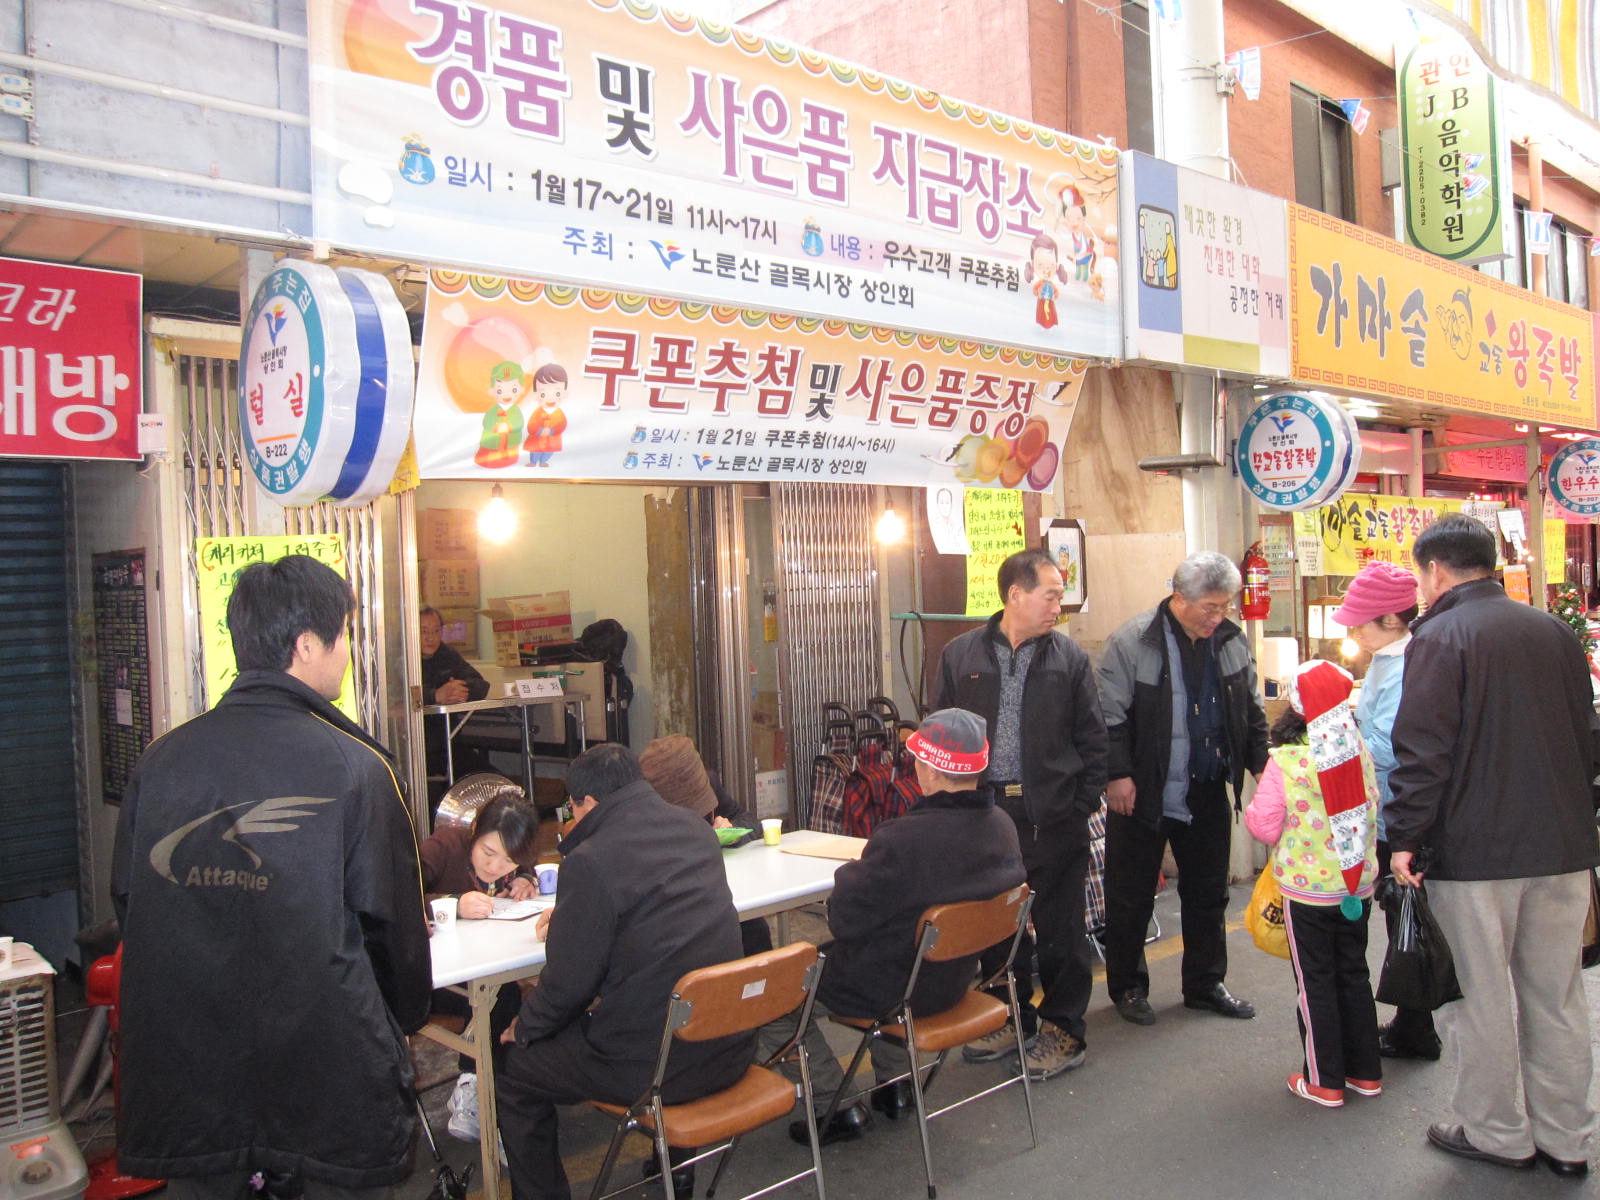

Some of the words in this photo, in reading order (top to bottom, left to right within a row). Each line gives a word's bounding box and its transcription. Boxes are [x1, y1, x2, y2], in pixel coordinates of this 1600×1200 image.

[412, 0, 568, 136] 경품
[599, 58, 653, 156] 및
[681, 72, 852, 201] 사은품
[872, 127, 1043, 241] 지급장소
[1437, 119, 1465, 242] 음악학원
[444, 156, 492, 192] 일시
[687, 206, 777, 245] 11시~17시
[1223, 215, 1242, 245] 환경
[563, 226, 613, 260] 주최
[692, 248, 760, 283] 노룬산
[770, 262, 850, 298] 골목시장
[860, 280, 914, 308] 상인회
[831, 235, 861, 261] 내용
[883, 241, 951, 279] 우수고객
[958, 256, 1020, 291] 쿠폰추첨
[1203, 245, 1235, 278] 친절한
[1242, 253, 1261, 283] 대화
[1230, 285, 1259, 316] 공정한
[1265, 292, 1283, 320] 거래
[1310, 262, 1430, 368] 가마솥
[584, 330, 801, 415] 쿠폰추첨
[806, 363, 841, 420] 및
[846, 358, 1036, 438] 사은품증정
[265, 444, 287, 458] B-222
[650, 428, 680, 445] 일시
[642, 452, 673, 470] 주최
[716, 455, 763, 472] 노룬산
[766, 456, 823, 473] 골목시장
[829, 458, 867, 475] 상인회
[917, 738, 952, 761] CANADA
[929, 754, 972, 771] SPORTS
[185, 866, 269, 891] Attaque
